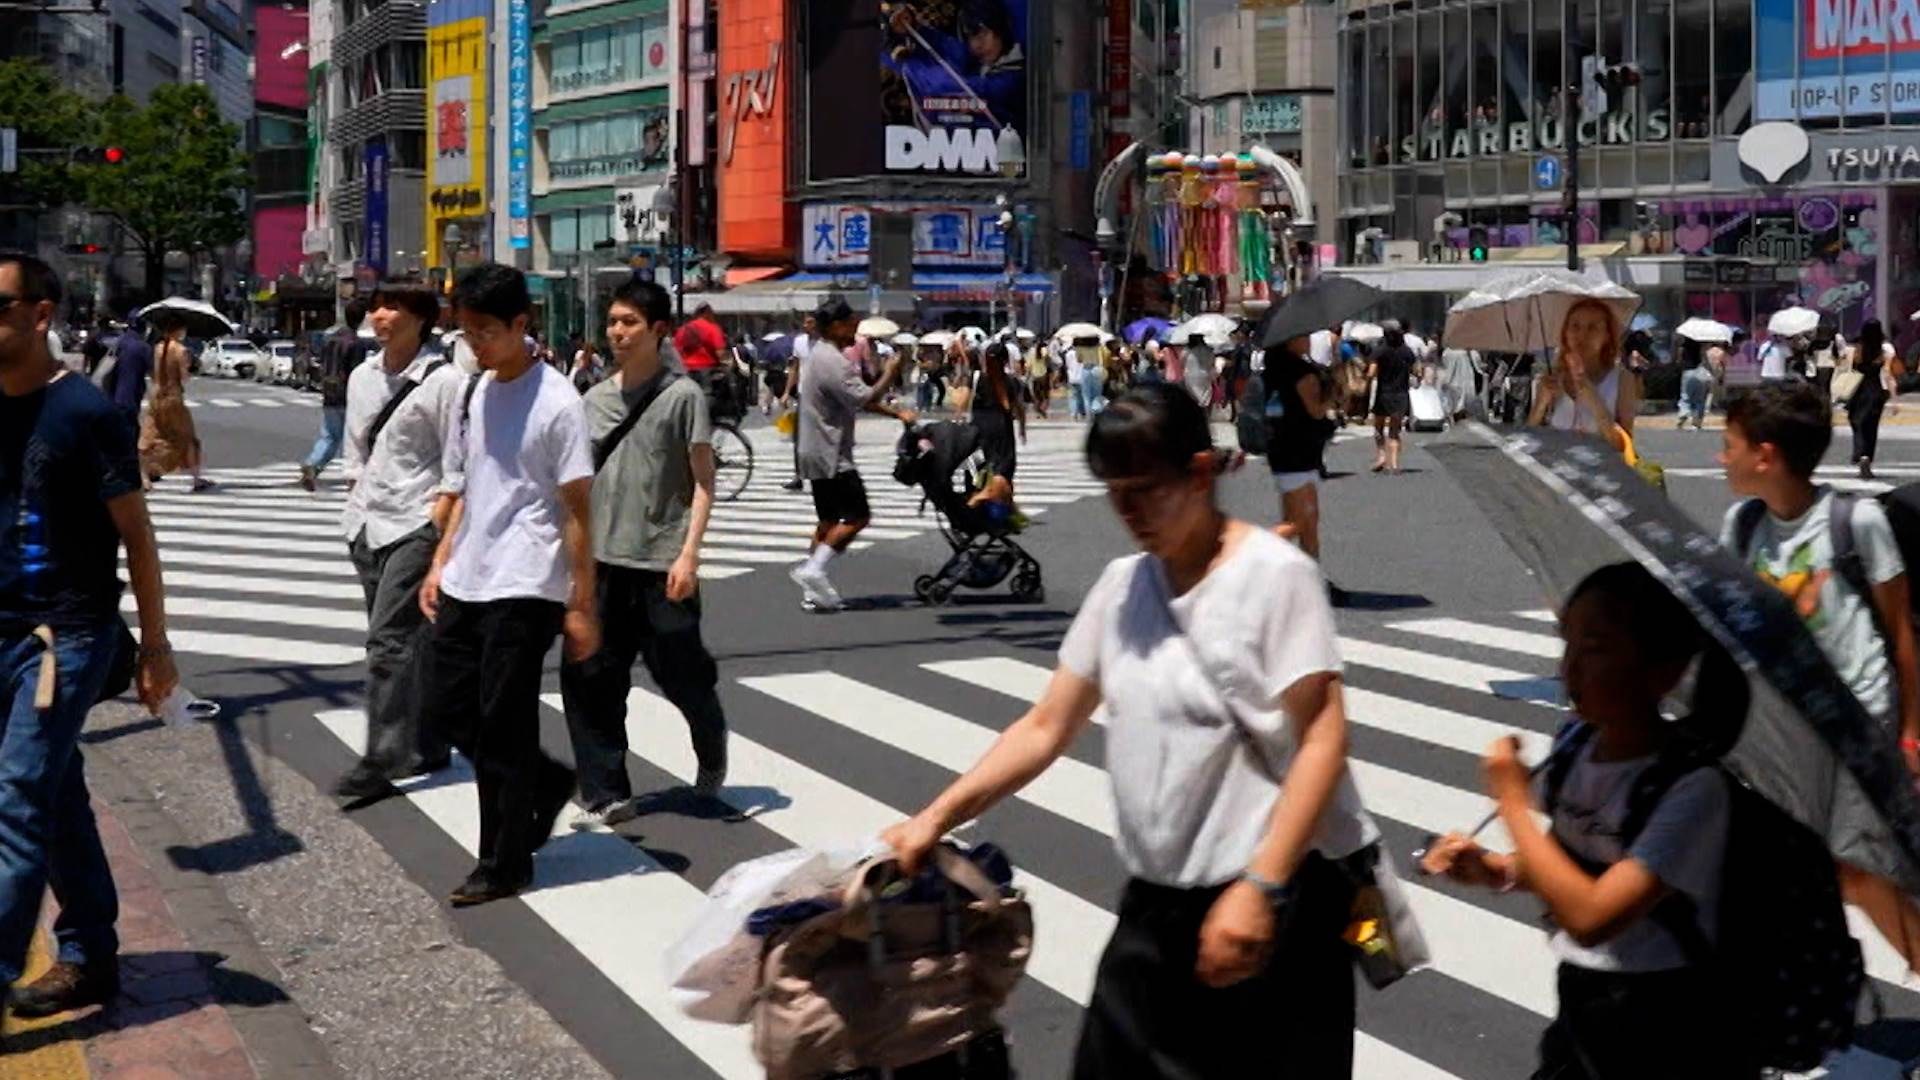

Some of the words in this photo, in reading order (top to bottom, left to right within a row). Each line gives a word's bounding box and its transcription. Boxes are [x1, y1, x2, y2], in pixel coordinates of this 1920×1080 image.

[722, 41, 782, 168] クスリ
[1400, 109, 1671, 163] STARBUCKS
[1827, 144, 1920, 166] TSUTA
